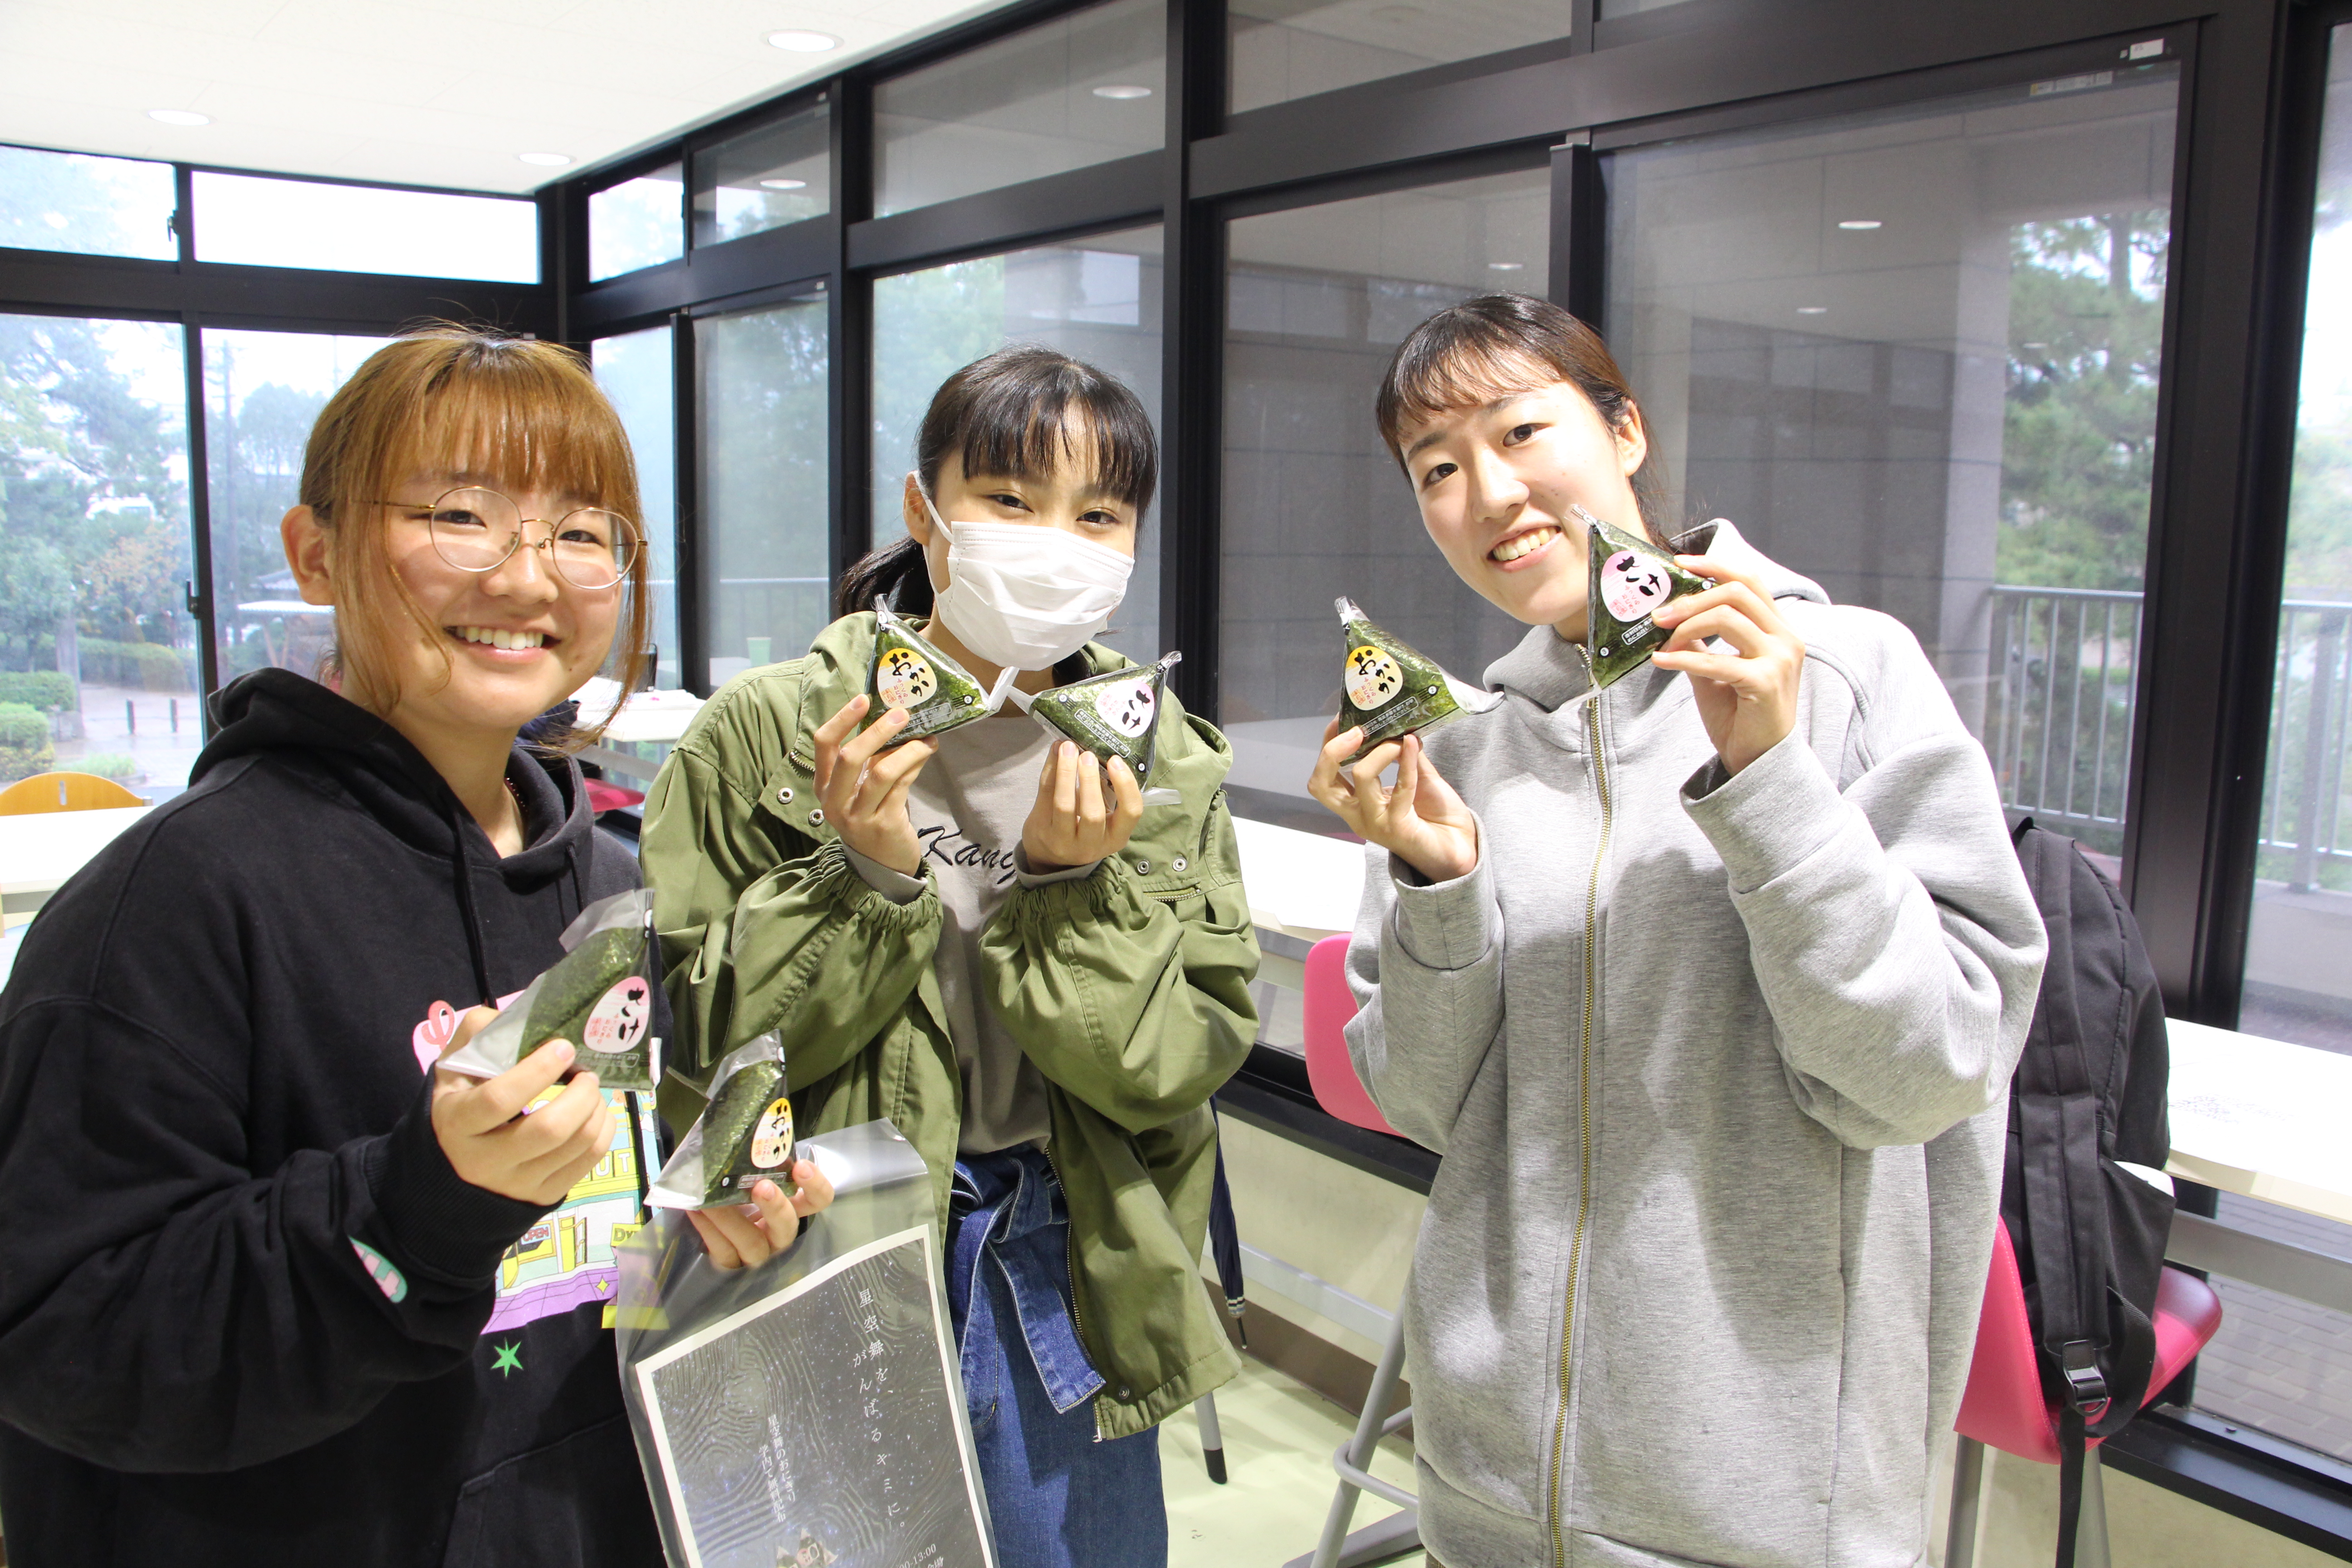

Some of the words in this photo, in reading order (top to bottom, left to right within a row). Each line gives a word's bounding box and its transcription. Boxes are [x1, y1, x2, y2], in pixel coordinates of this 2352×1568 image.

[1622, 594, 1637, 614] おにぎり
[1624, 585, 1640, 605] ふっくら
[889, 652, 929, 696] おかか
[1354, 650, 1395, 694] おかか
[893, 685, 904, 704] おにぎり
[897, 678, 908, 697] ふっくら
[1361, 685, 1373, 704] おにぎり
[1364, 677, 1376, 697] ふっくら
[771, 1103, 789, 1160] おかか
[584, 1152, 631, 1179] UT
[522, 1226, 549, 1241] OPEN
[859, 1288, 895, 1394] 星空舞を、
[853, 1349, 906, 1528] がんばるキミに。
[768, 1416, 796, 1503] 星空舞のおにぎり
